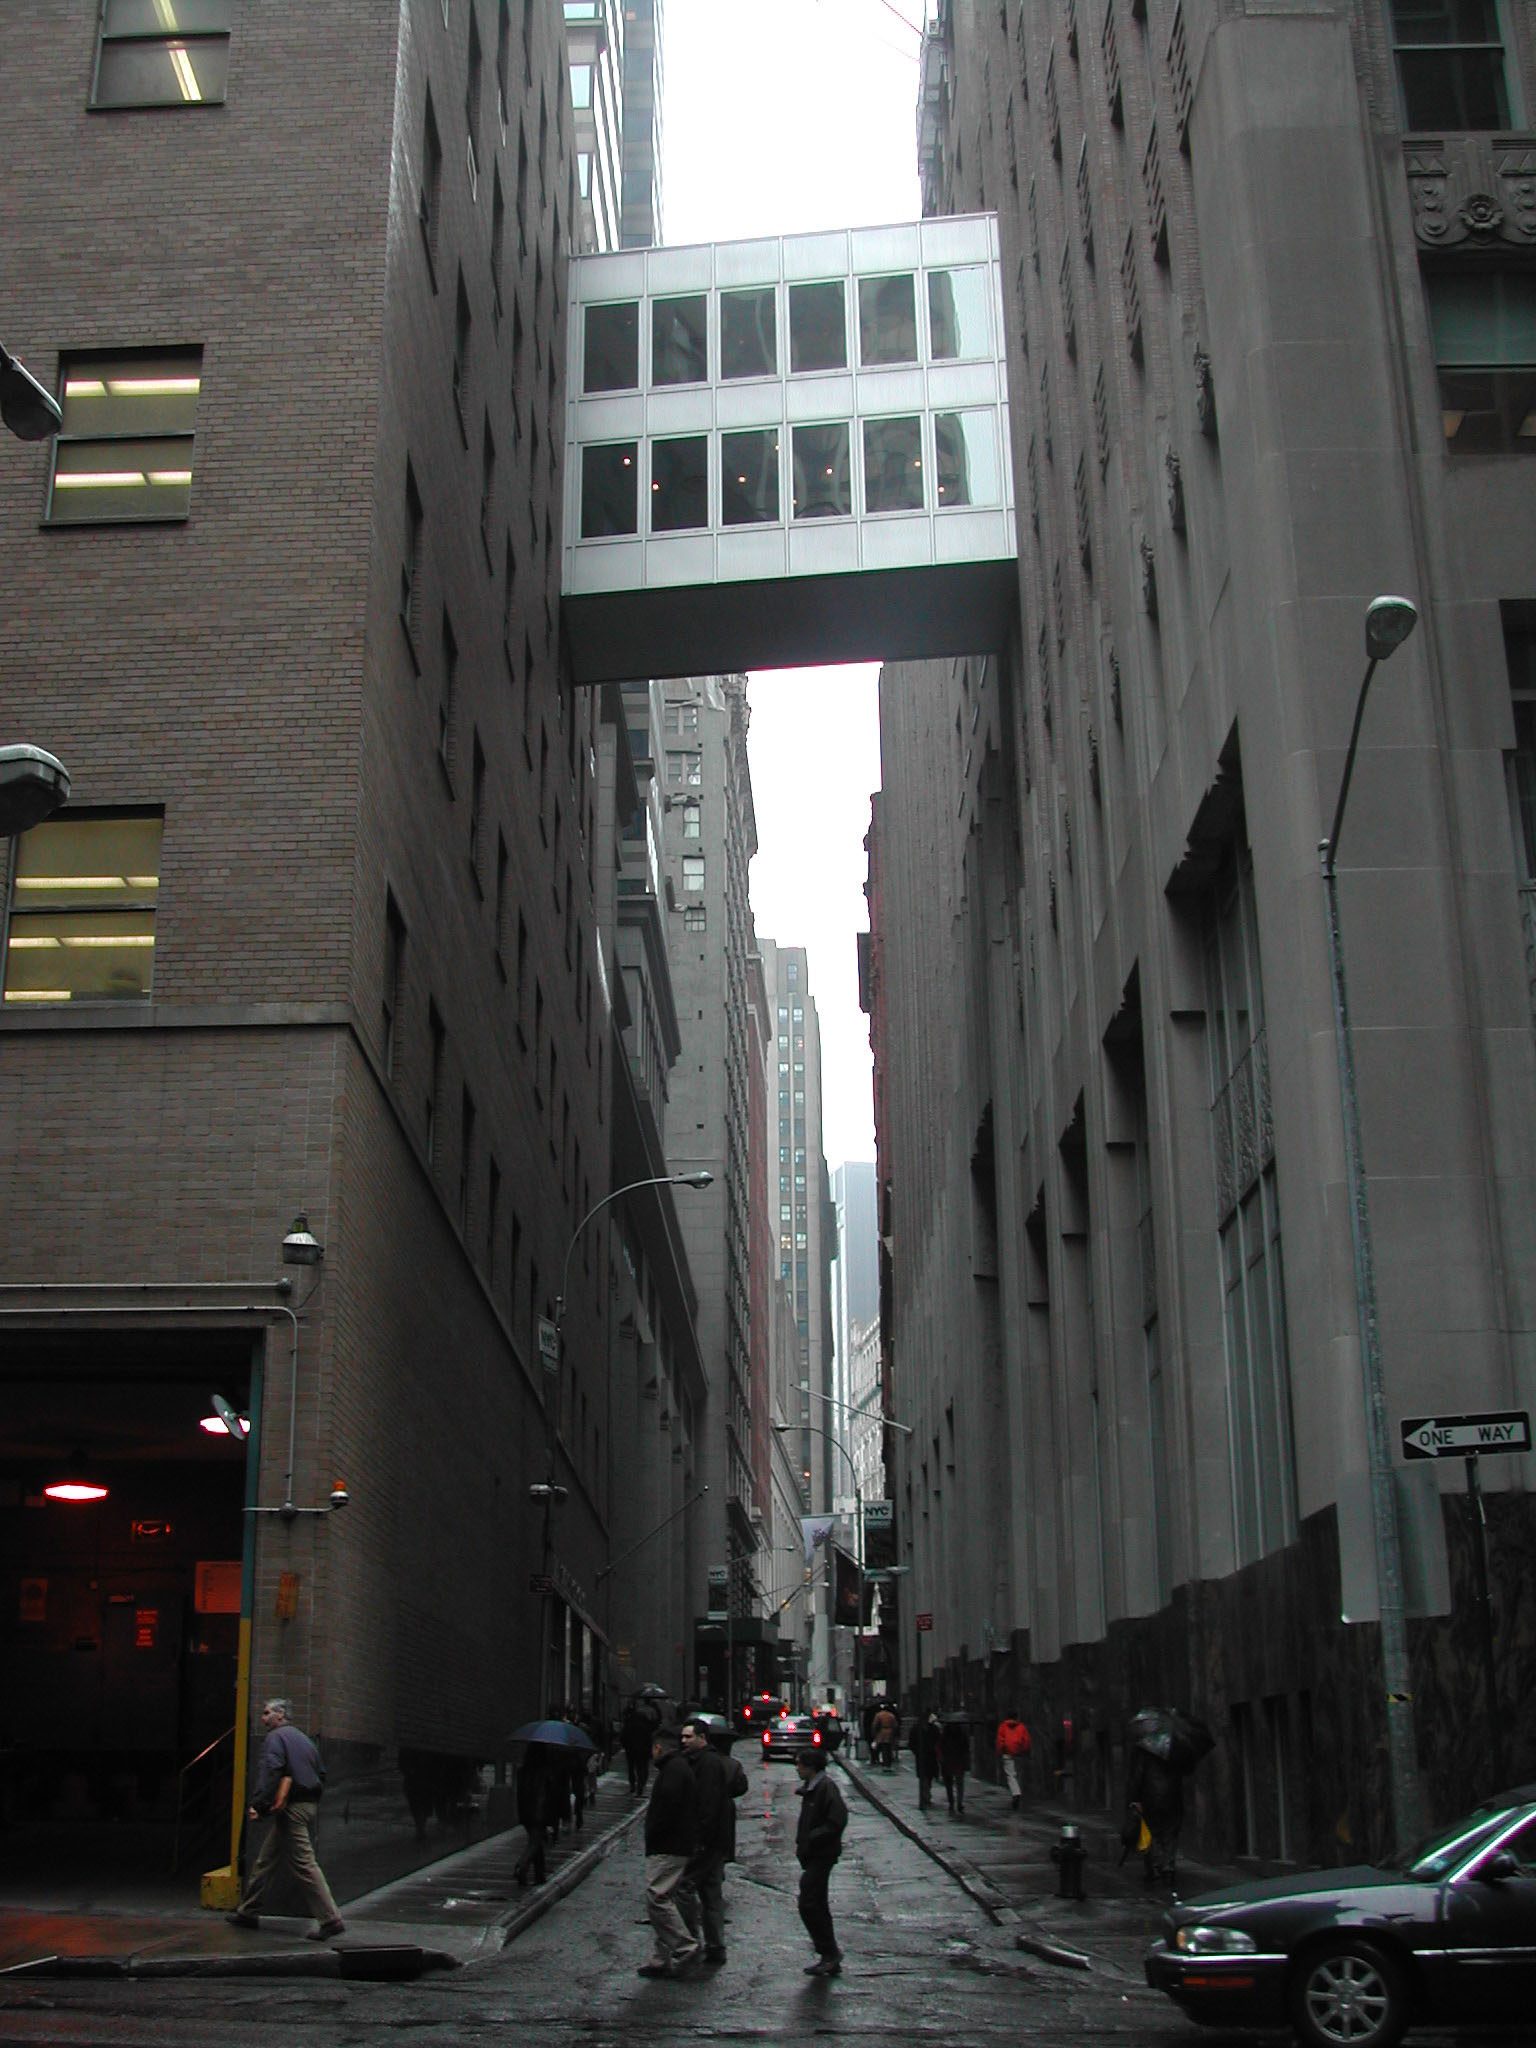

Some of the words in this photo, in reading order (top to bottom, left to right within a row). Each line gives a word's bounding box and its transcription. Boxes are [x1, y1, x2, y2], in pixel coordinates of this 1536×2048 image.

[1419, 1429, 1454, 1446] ONE
[1478, 1425, 1514, 1441] WAY
[865, 1506, 889, 1516] NYC
